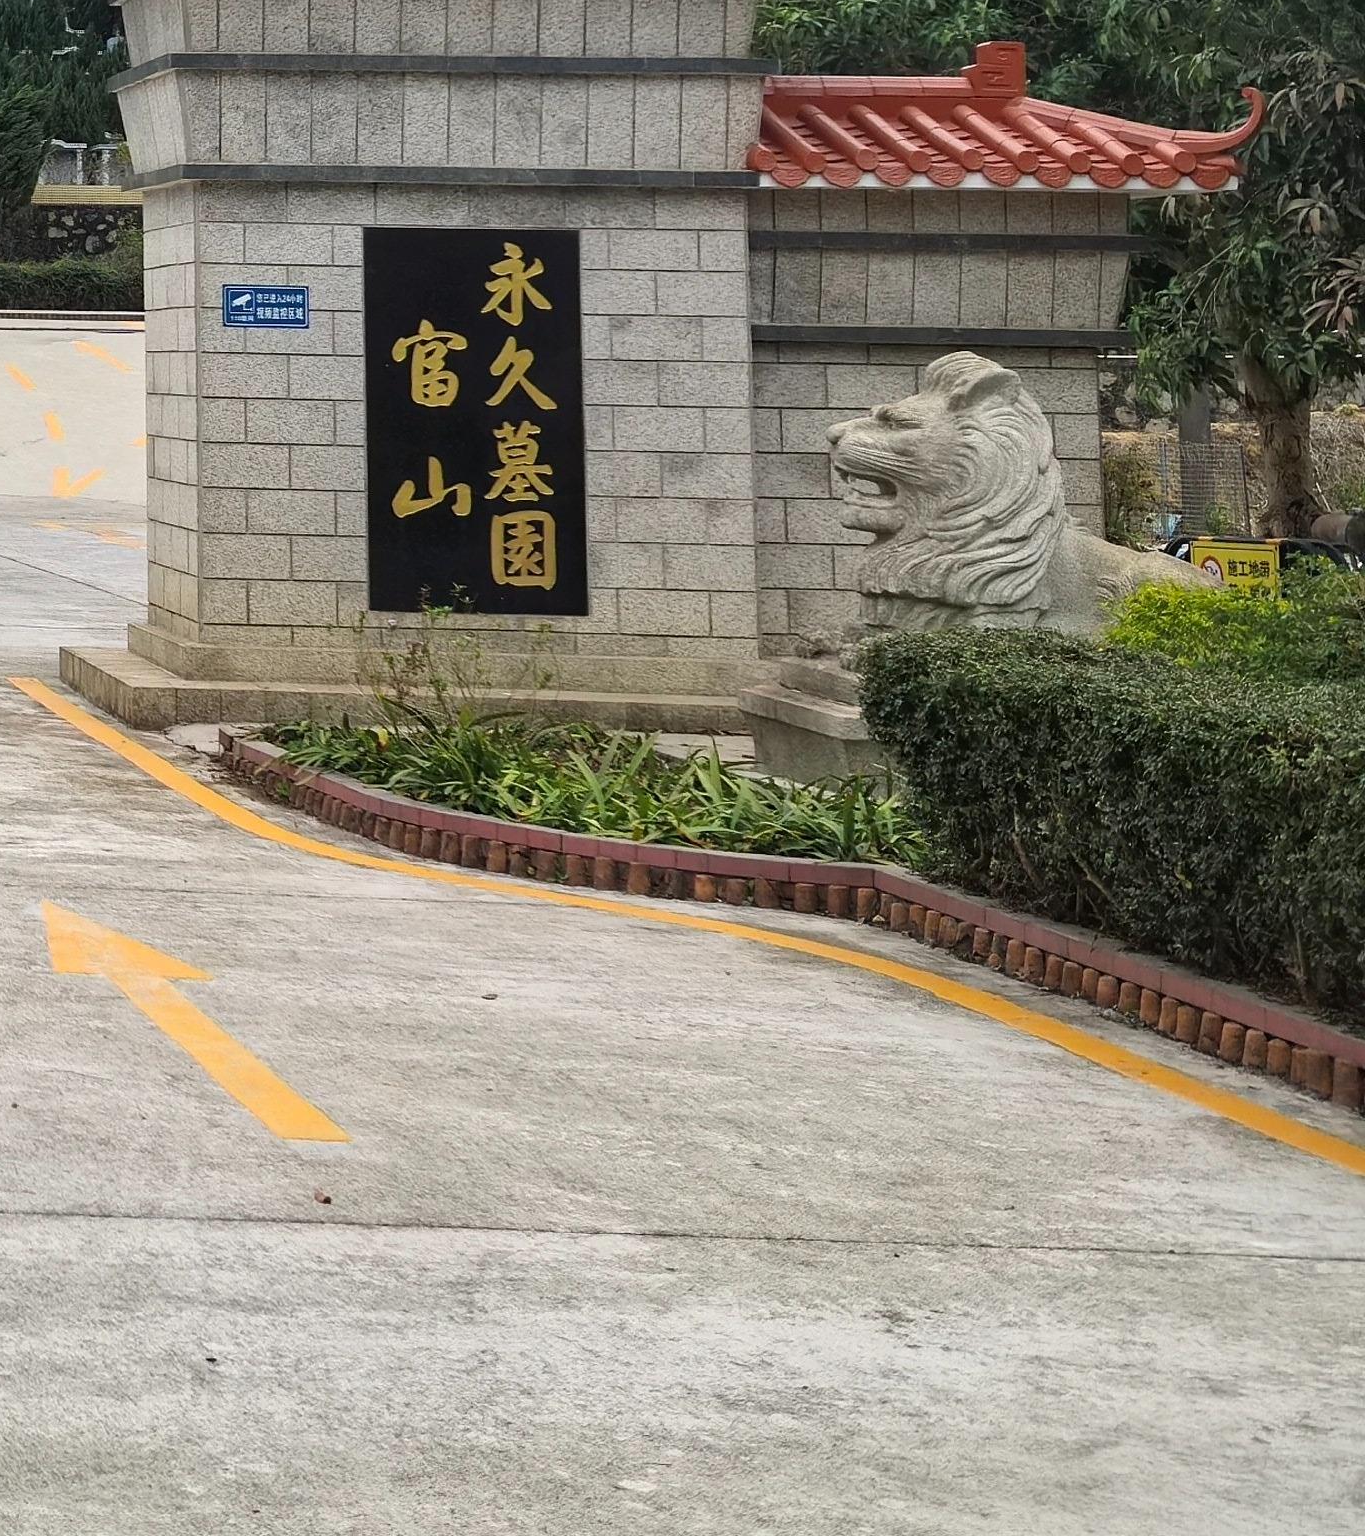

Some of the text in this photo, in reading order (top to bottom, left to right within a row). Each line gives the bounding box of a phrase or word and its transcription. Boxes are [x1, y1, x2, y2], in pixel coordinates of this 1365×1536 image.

[392, 319, 471, 519] 富山
[480, 242, 558, 591] 永久墓園
